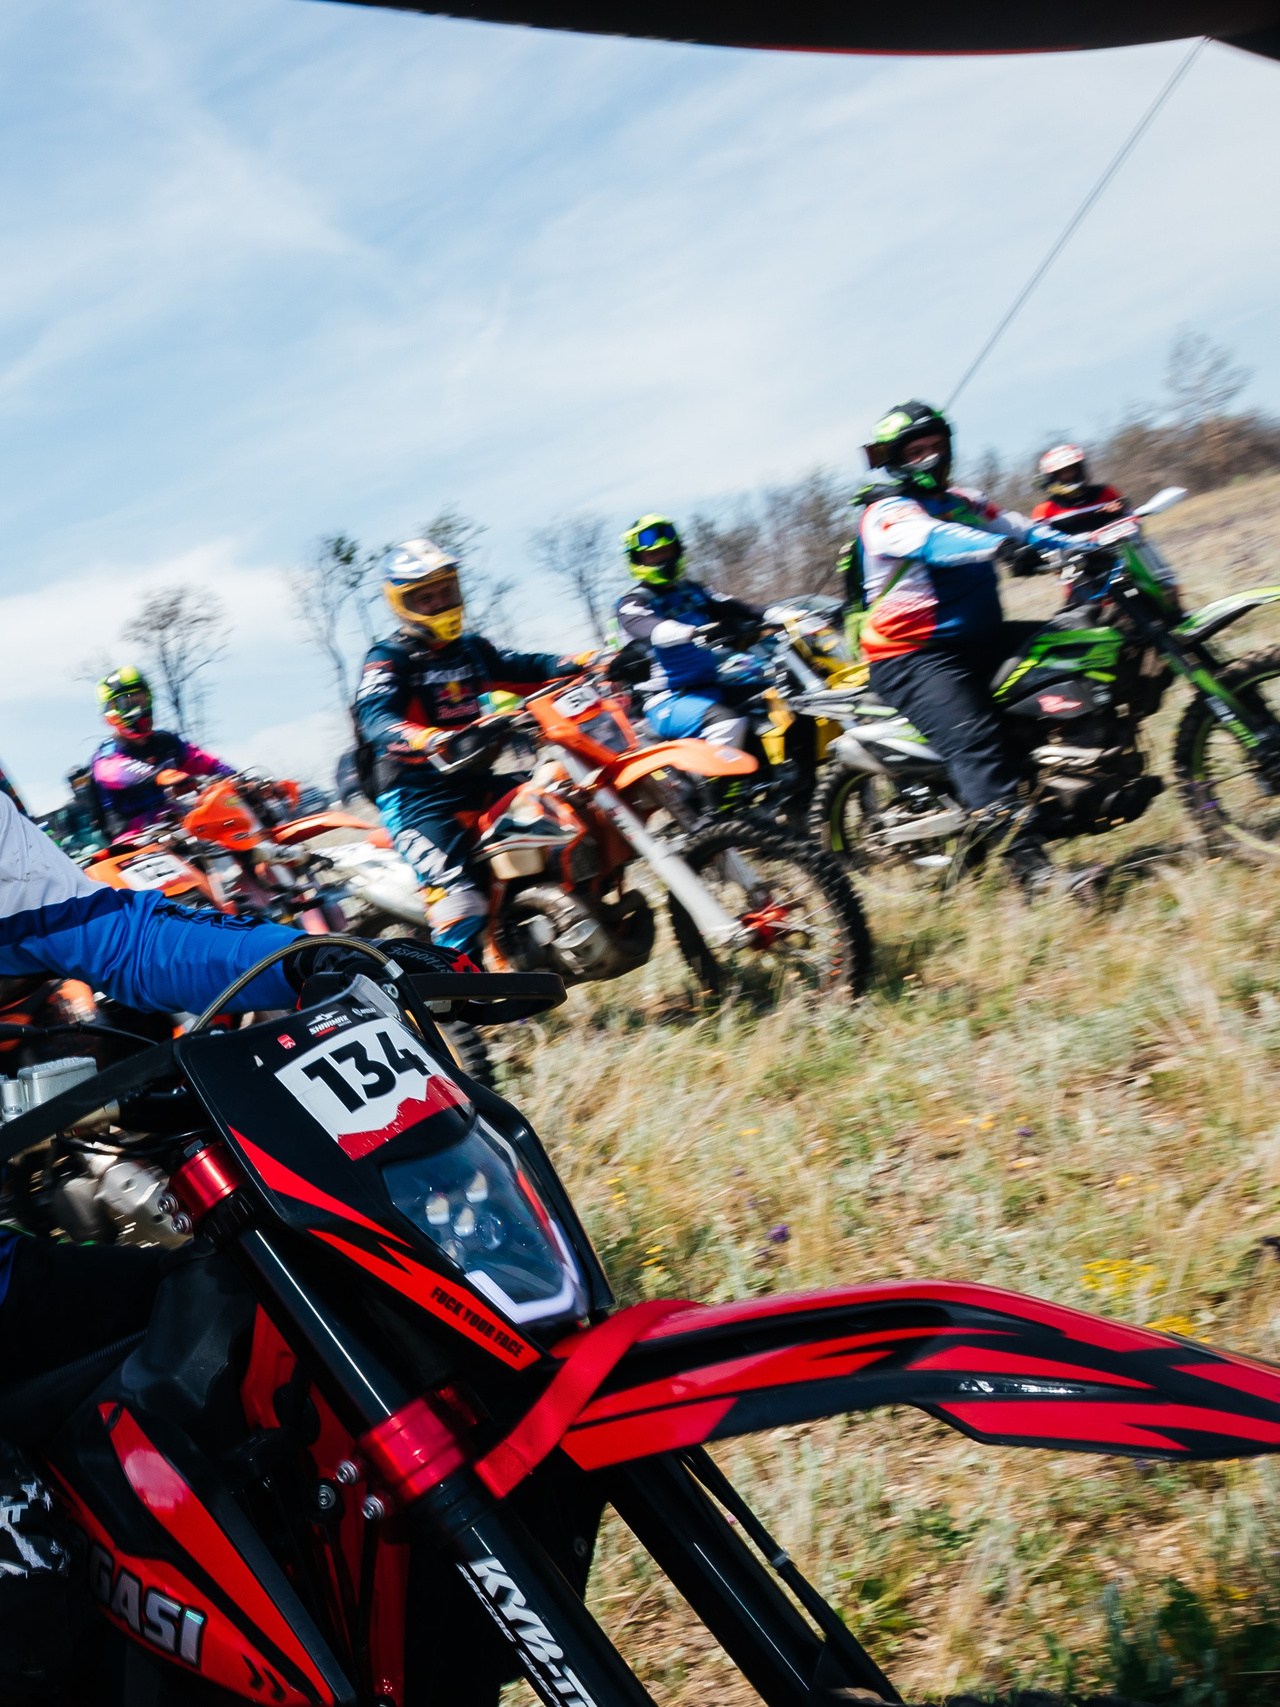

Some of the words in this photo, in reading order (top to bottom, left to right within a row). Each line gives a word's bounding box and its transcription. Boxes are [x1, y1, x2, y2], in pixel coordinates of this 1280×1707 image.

[301, 1031, 432, 1114] 134
[430, 1286, 464, 1316] FUCK
[461, 1308, 495, 1338] YOUR
[493, 1331, 525, 1358] FACE
